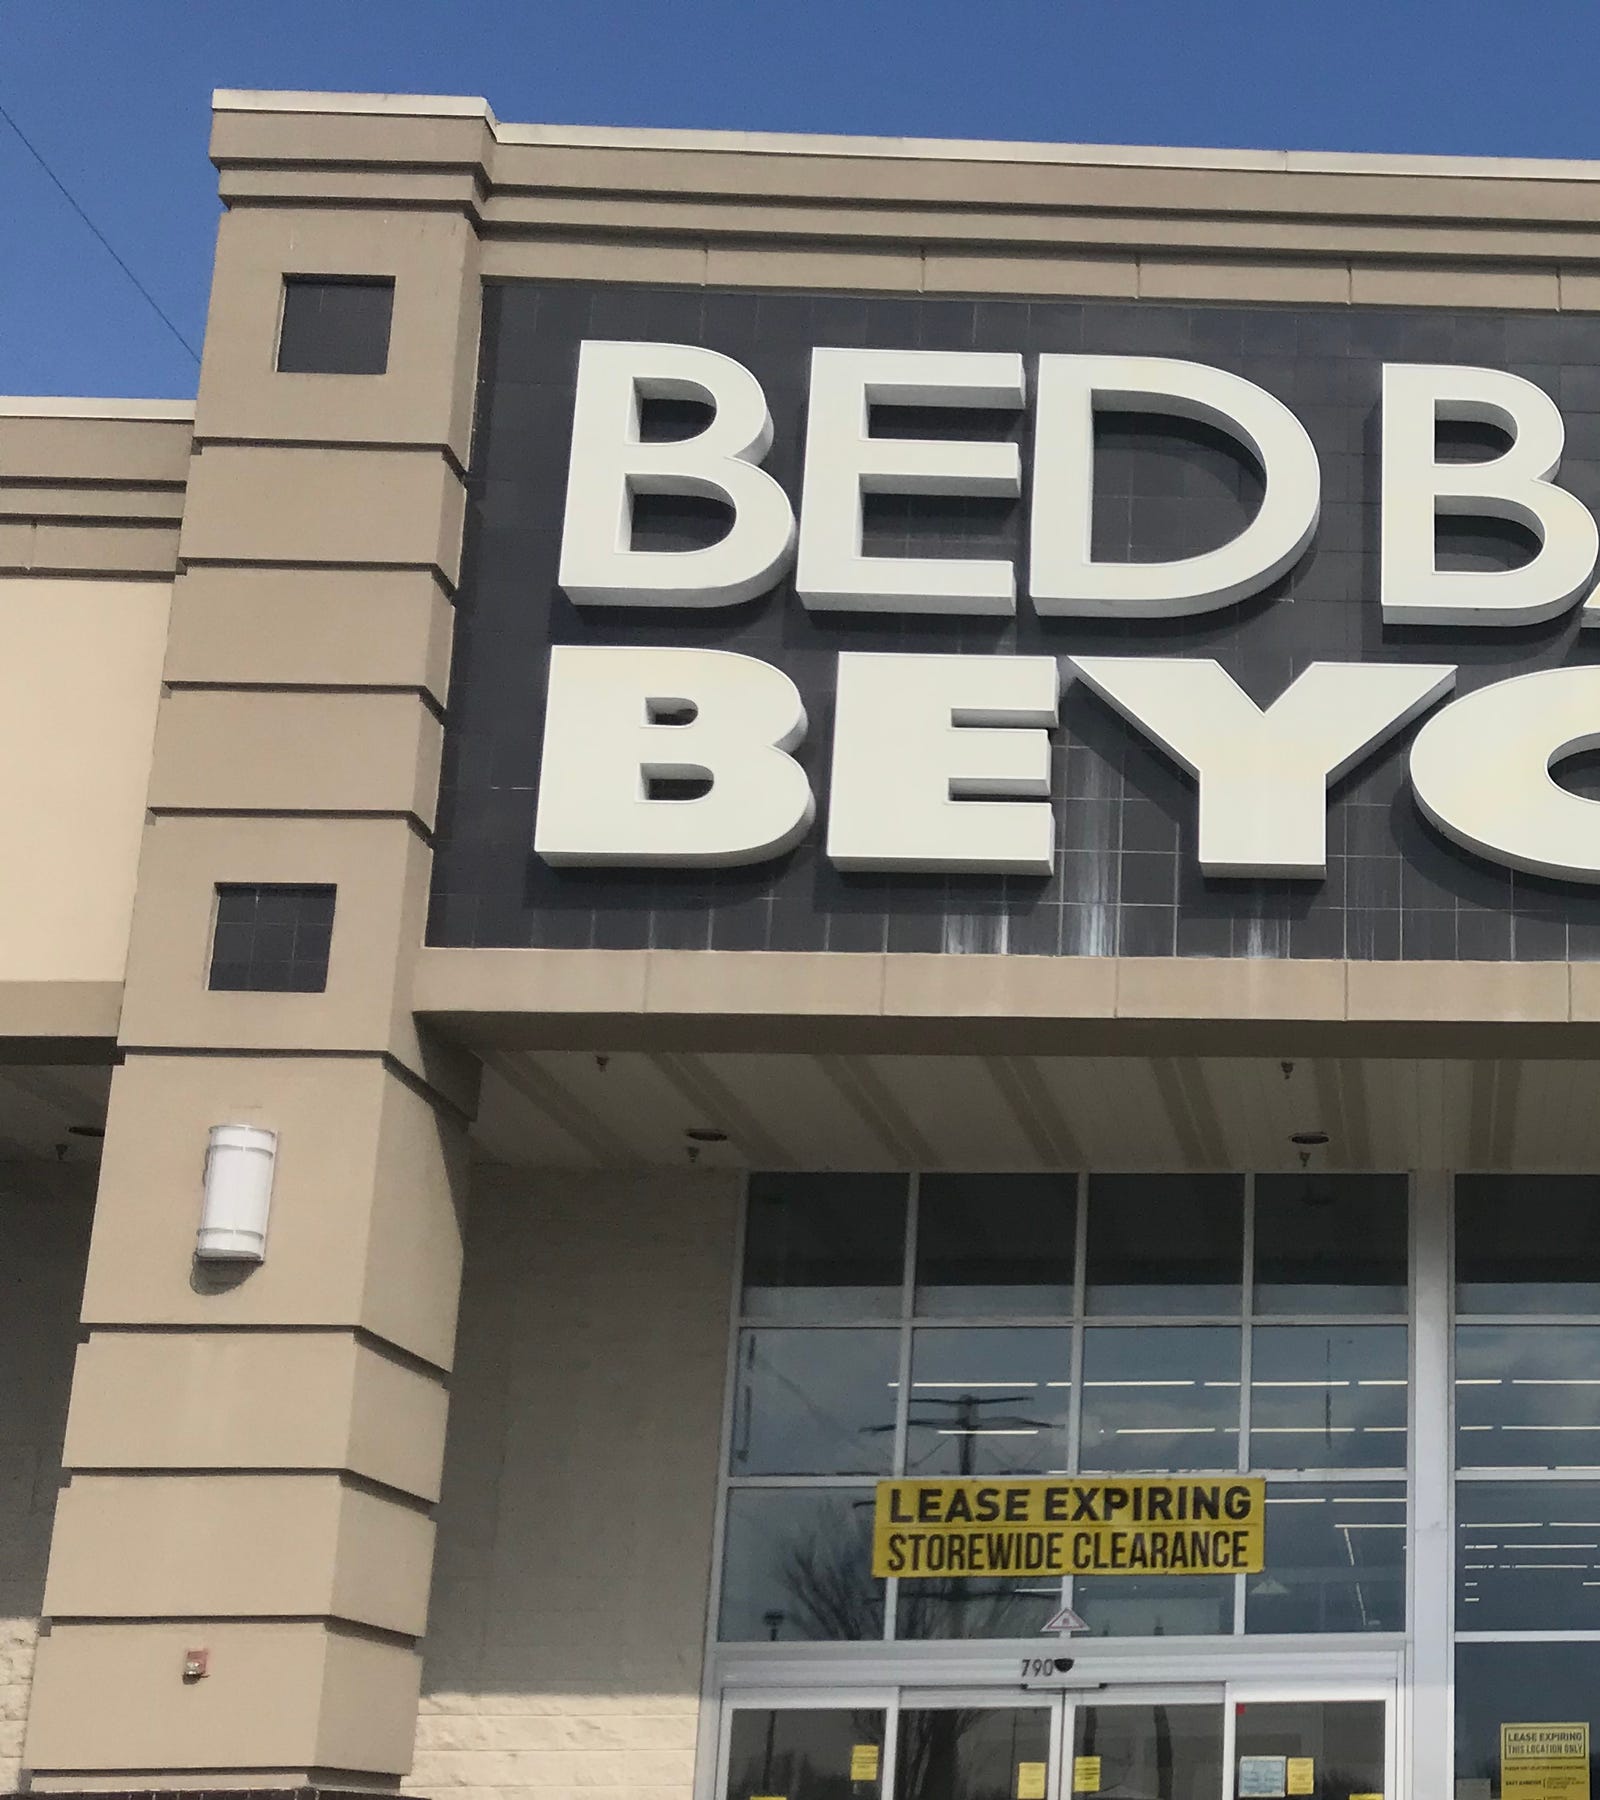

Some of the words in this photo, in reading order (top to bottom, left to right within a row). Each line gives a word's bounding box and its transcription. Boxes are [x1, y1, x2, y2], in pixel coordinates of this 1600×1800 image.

[558, 340, 1321, 618] BED
[889, 1487, 1031, 1523] LEASE
[1043, 1485, 1252, 1521] EXPIRING
[887, 1532, 1063, 1571] STOREWIDE
[1072, 1530, 1250, 1569] CLEARANCE
[1021, 1658, 1054, 1677] 790
[1508, 1732, 1537, 1742] LEASE
[1539, 1732, 1583, 1742] EXPIRING
[1508, 1745, 1525, 1754] THIS
[1526, 1744, 1562, 1754] LOCATION
[1564, 1744, 1583, 1753] ONLY
